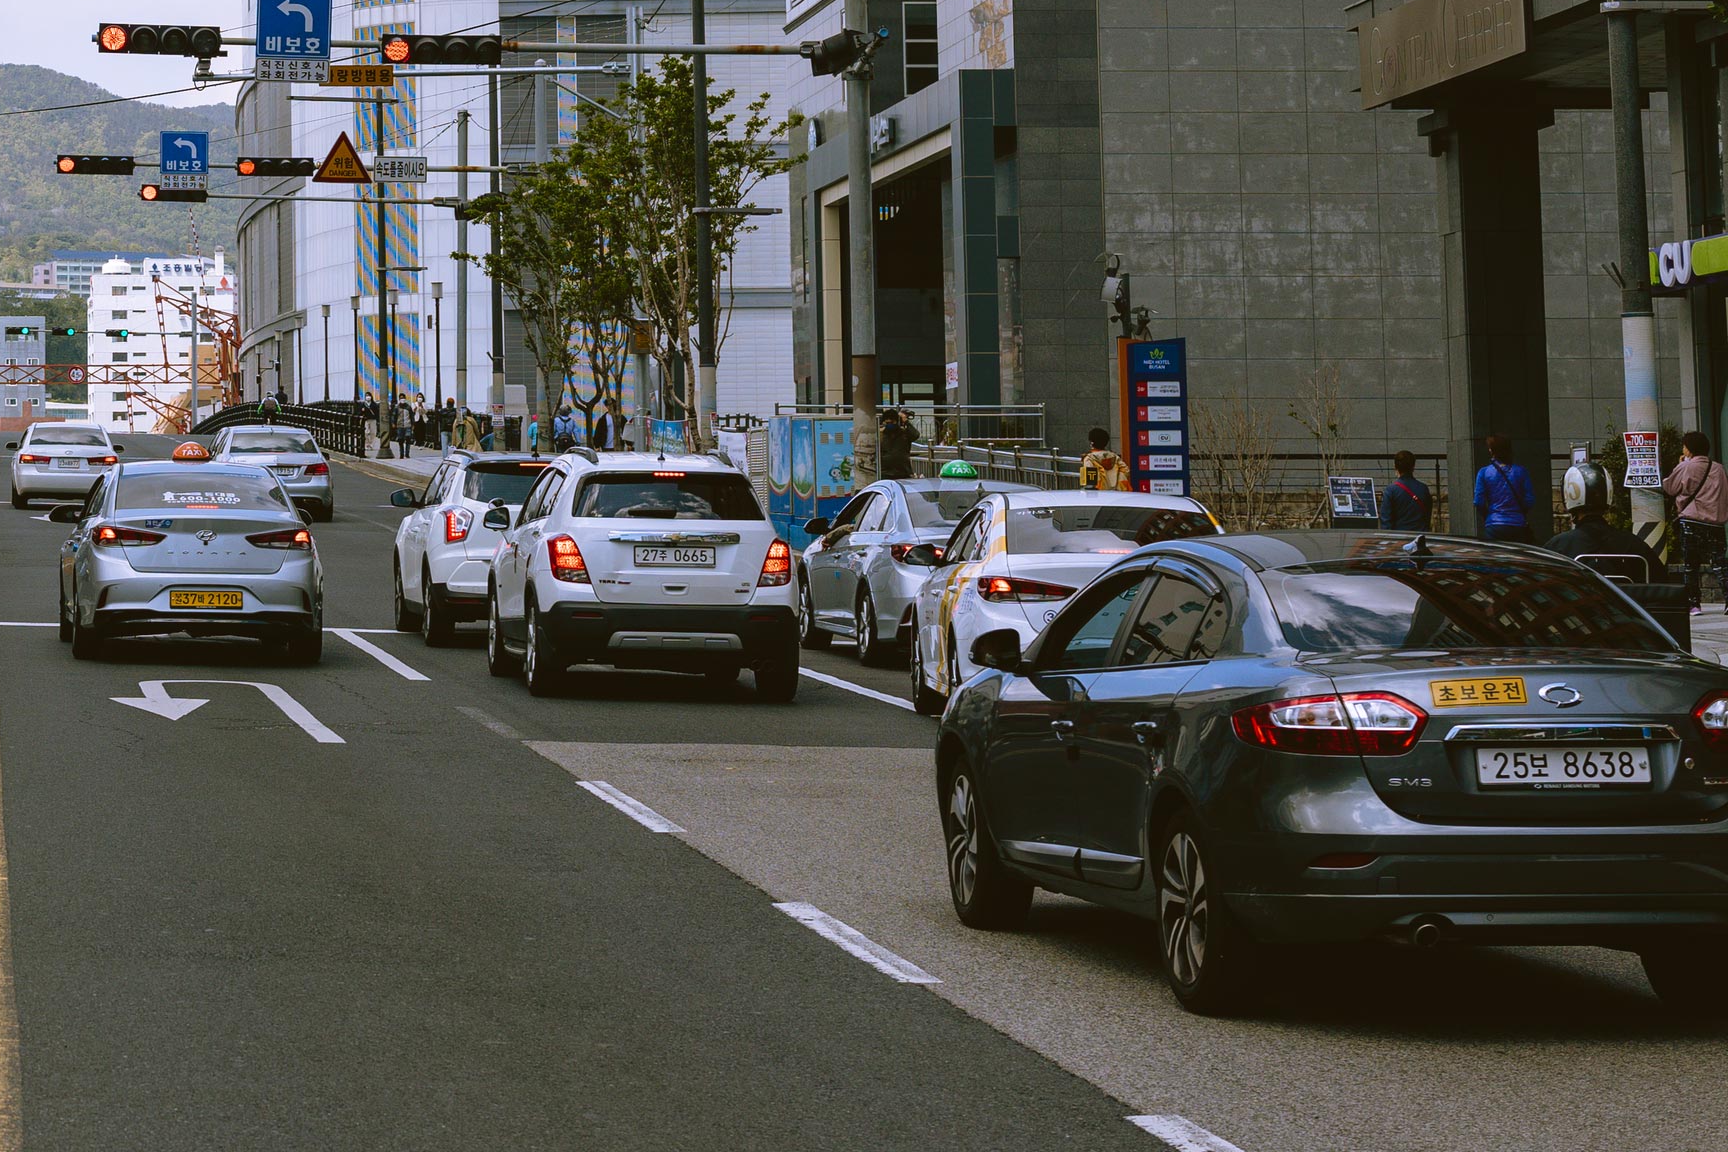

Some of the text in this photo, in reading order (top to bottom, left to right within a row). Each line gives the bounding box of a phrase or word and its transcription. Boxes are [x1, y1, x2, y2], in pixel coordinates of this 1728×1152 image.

[265, 36, 321, 54] 비보호
[260, 60, 325, 71] 직진신호시
[260, 70, 326, 81] 좌회전가능
[166, 159, 202, 171] 비보호
[333, 157, 354, 169] 위험
[1659, 239, 1692, 288] CU
[642, 549, 708, 563] 27주 0665
[207, 593, 239, 606] 2120
[1438, 681, 1522, 703] 초보운전
[1493, 750, 1635, 779] 25보 8638
[1387, 777, 1433, 787] SM3
